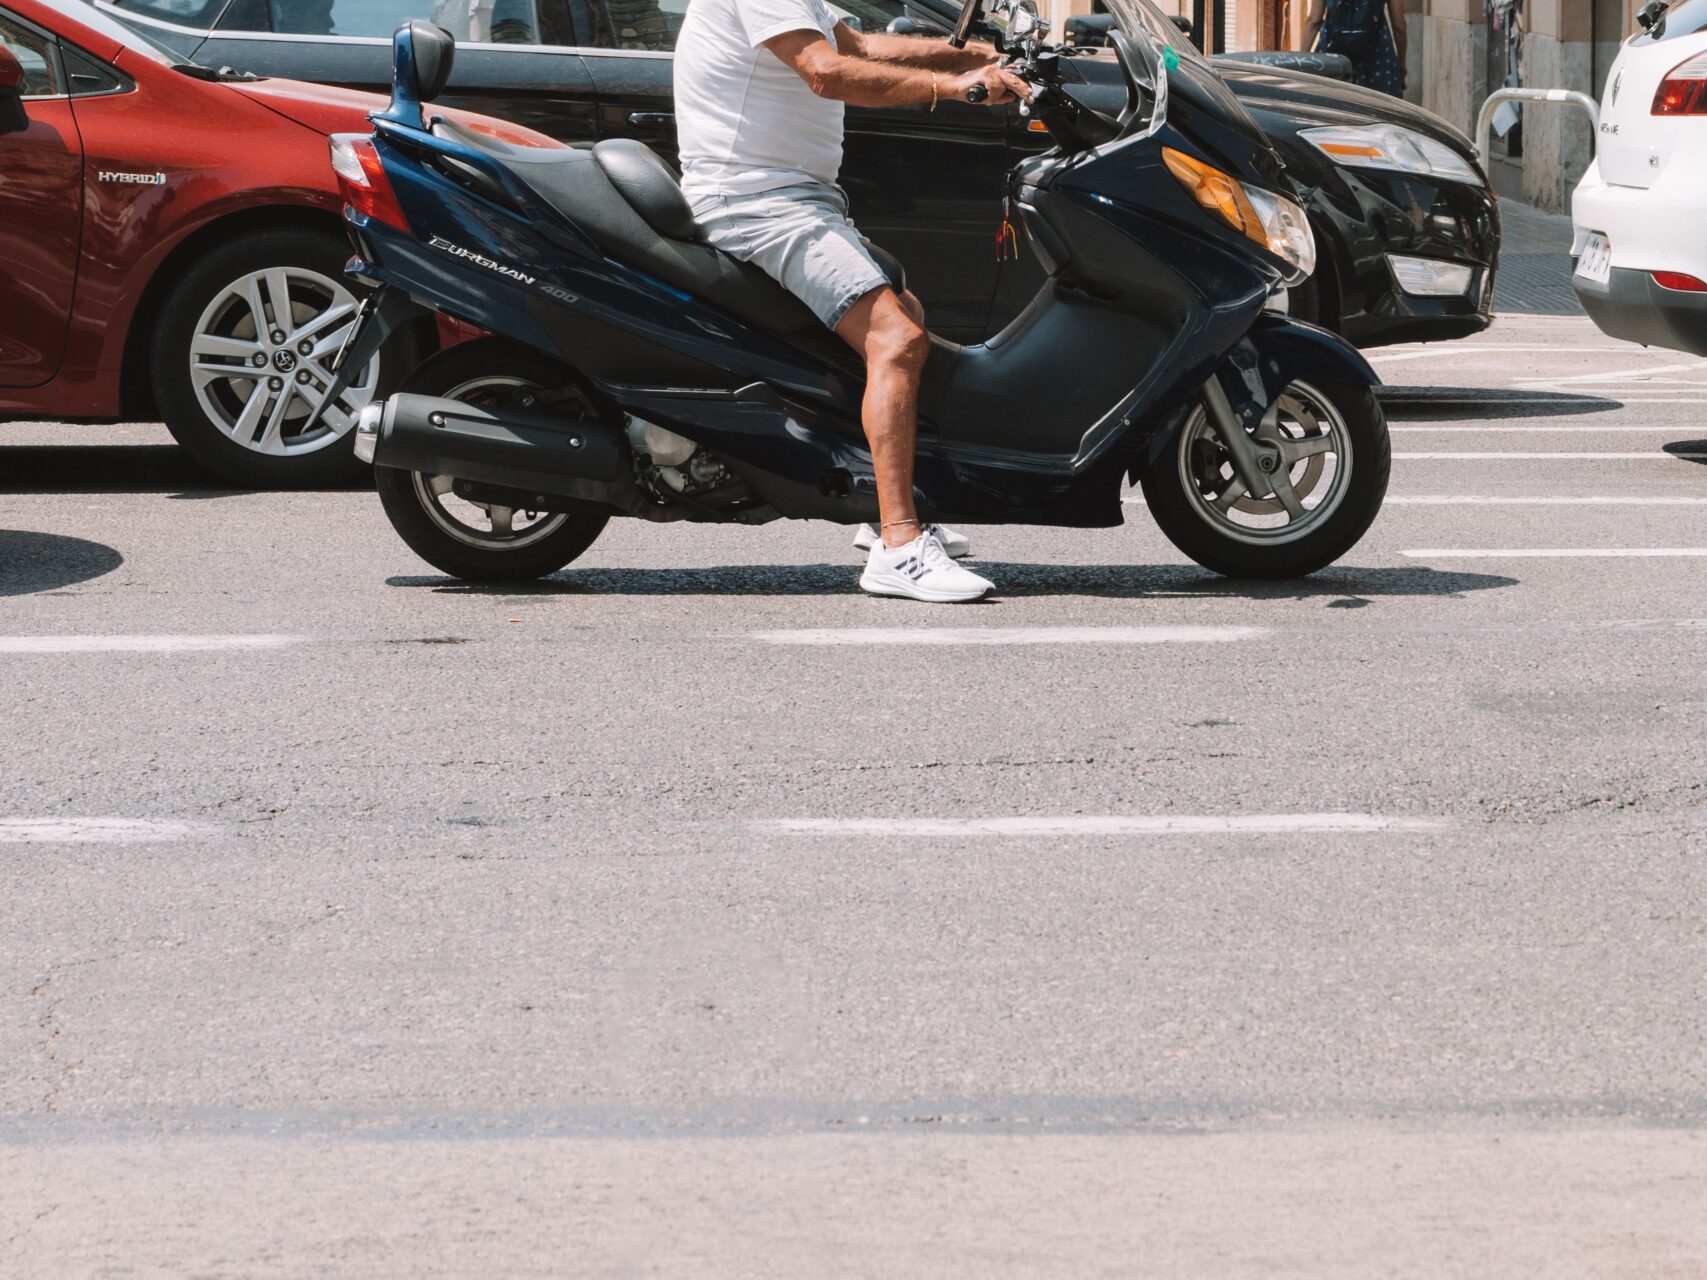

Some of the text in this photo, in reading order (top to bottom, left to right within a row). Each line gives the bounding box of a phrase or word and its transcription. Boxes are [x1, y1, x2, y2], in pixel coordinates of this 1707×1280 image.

[98, 171, 158, 185] HYBRID
[428, 233, 536, 285] BURGMAN
[538, 284, 580, 304] 400
